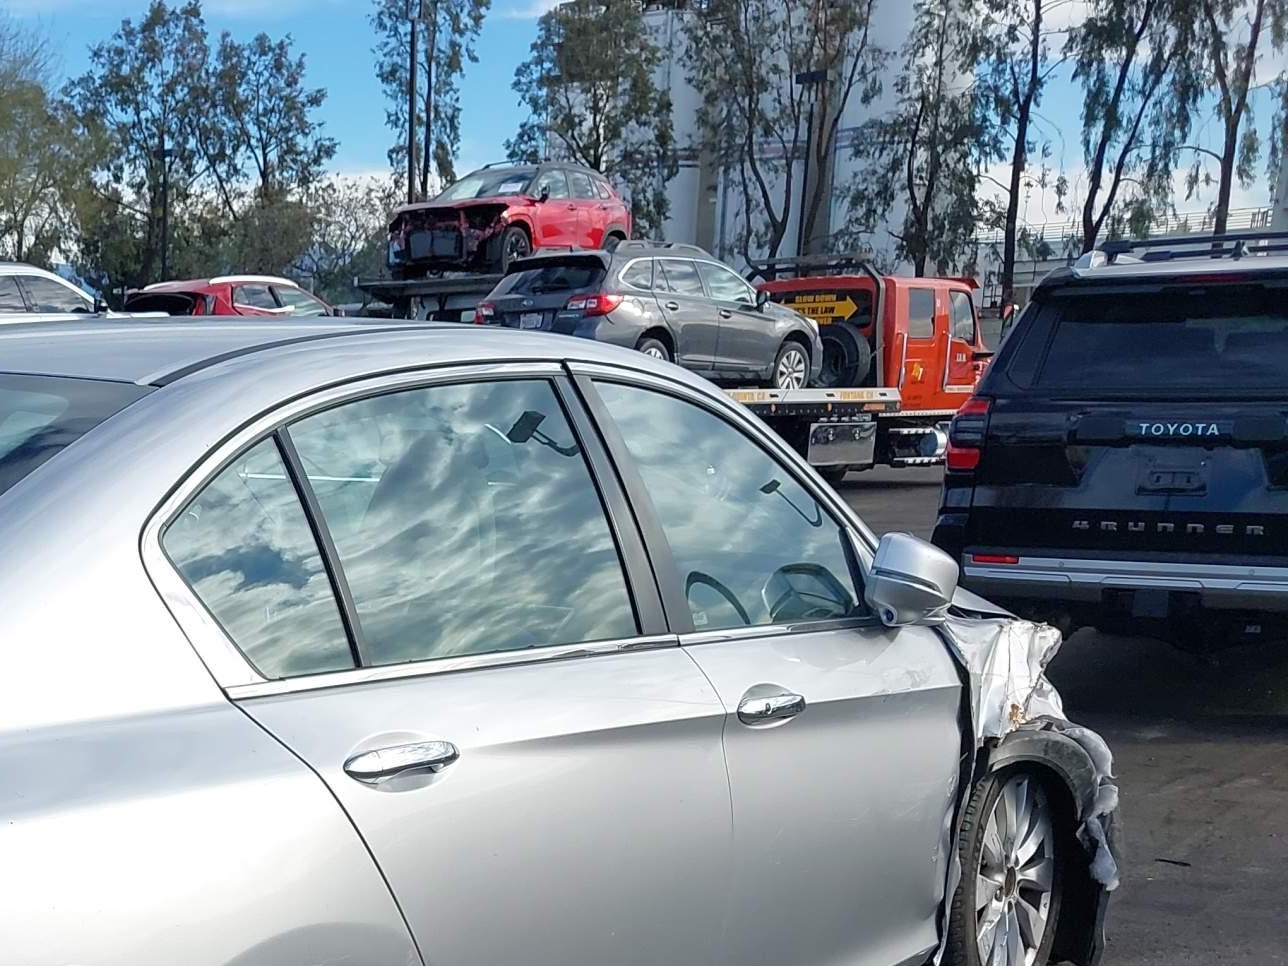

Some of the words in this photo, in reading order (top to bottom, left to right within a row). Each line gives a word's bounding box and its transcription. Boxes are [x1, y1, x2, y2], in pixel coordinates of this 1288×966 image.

[807, 307, 820, 315] THE
[821, 306, 836, 315] LAW
[1139, 423, 1220, 436] TOYOTA
[1072, 520, 1265, 536] 4RUNNER
